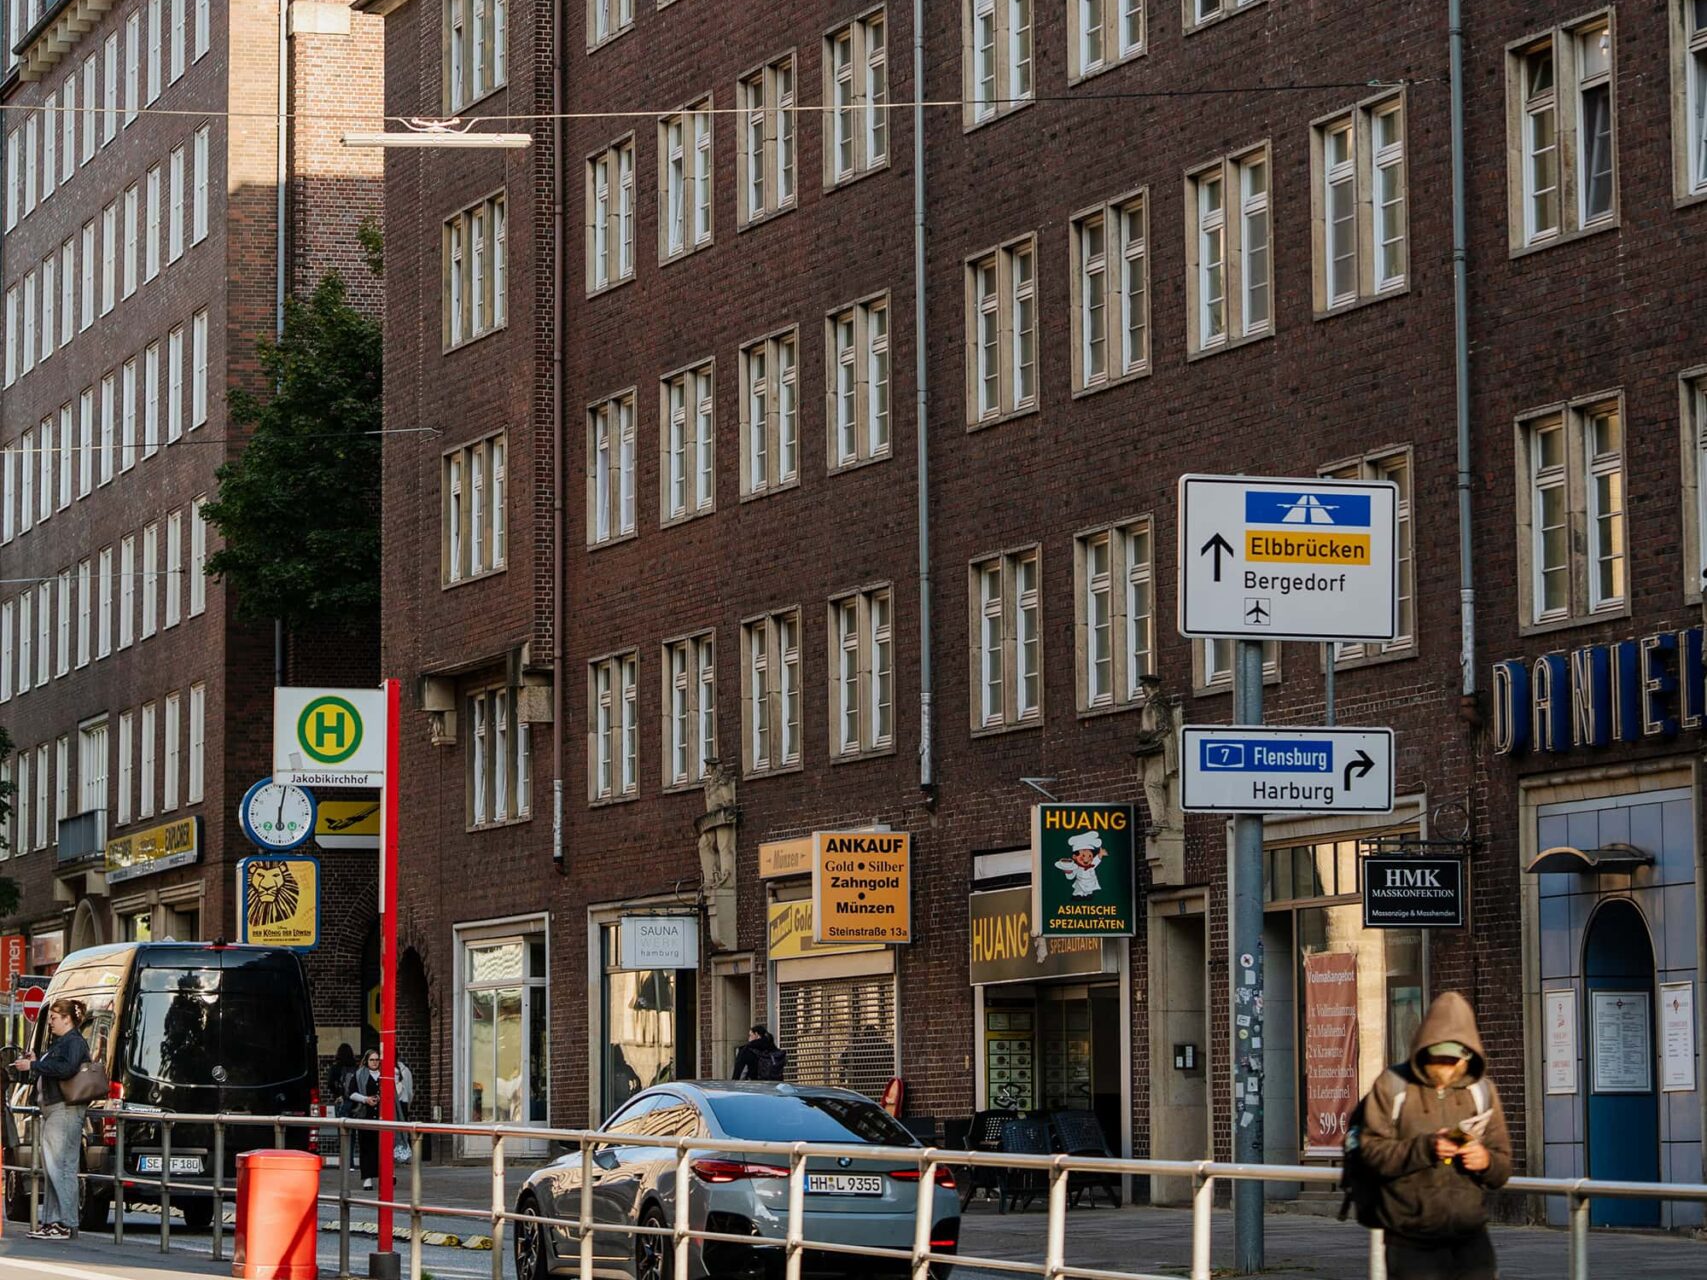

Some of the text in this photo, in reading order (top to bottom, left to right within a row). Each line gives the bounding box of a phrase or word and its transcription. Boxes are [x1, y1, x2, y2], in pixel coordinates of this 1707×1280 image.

[1251, 536, 1365, 559] Elbbrücken
[1244, 571, 1346, 595] Bergedorf
[315, 711, 345, 748] H
[1220, 746, 1327, 770] 7 Flensburg
[290, 773, 368, 785] Jakobikirchhof
[1252, 781, 1334, 804] Harburg
[1045, 810, 1126, 830] HUANG
[825, 838, 904, 854] ANKAUF
[825, 860, 905, 872] Gold Silber
[831, 876, 899, 891] Zahngold
[1384, 868, 1441, 887] HMK
[1372, 888, 1455, 898] MASSKONFEKTION
[836, 901, 895, 914] Münzen
[1057, 905, 1117, 916] ASIATISCHE
[794, 904, 812, 933] Gold
[1049, 917, 1125, 929] SPEZIALITÄTEN
[640, 925, 679, 936] SAUNA
[829, 926, 907, 937] Steinstraße 13a
[973, 912, 1030, 963] HUANG
[641, 950, 679, 958] hamburg
[1319, 1111, 1347, 1135] 599 €
[147, 1158, 159, 1169] SE
[810, 1176, 880, 1192] HH L 9355
